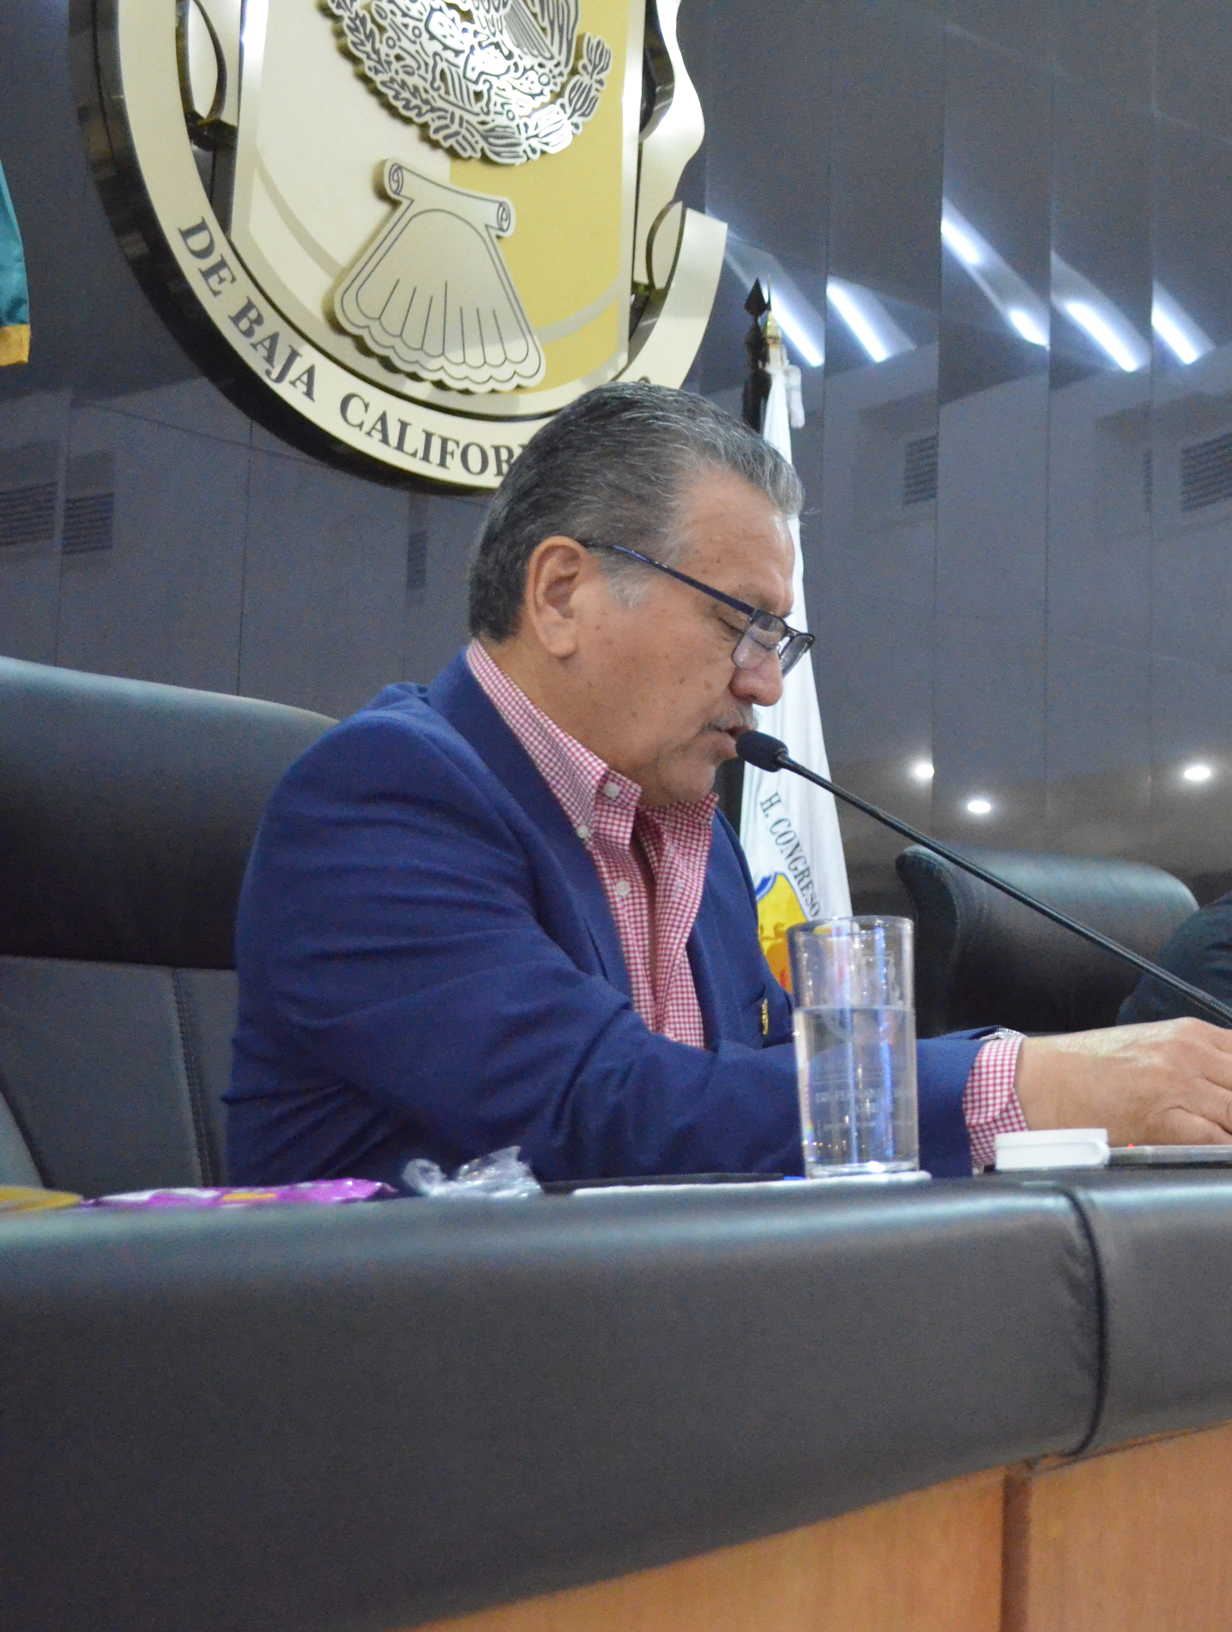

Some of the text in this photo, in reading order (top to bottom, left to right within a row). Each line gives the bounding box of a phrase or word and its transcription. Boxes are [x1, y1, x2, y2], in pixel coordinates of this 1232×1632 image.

[178, 216, 528, 477] DE BAJA CALIFOR
[768, 817, 820, 919] CONGRESO
